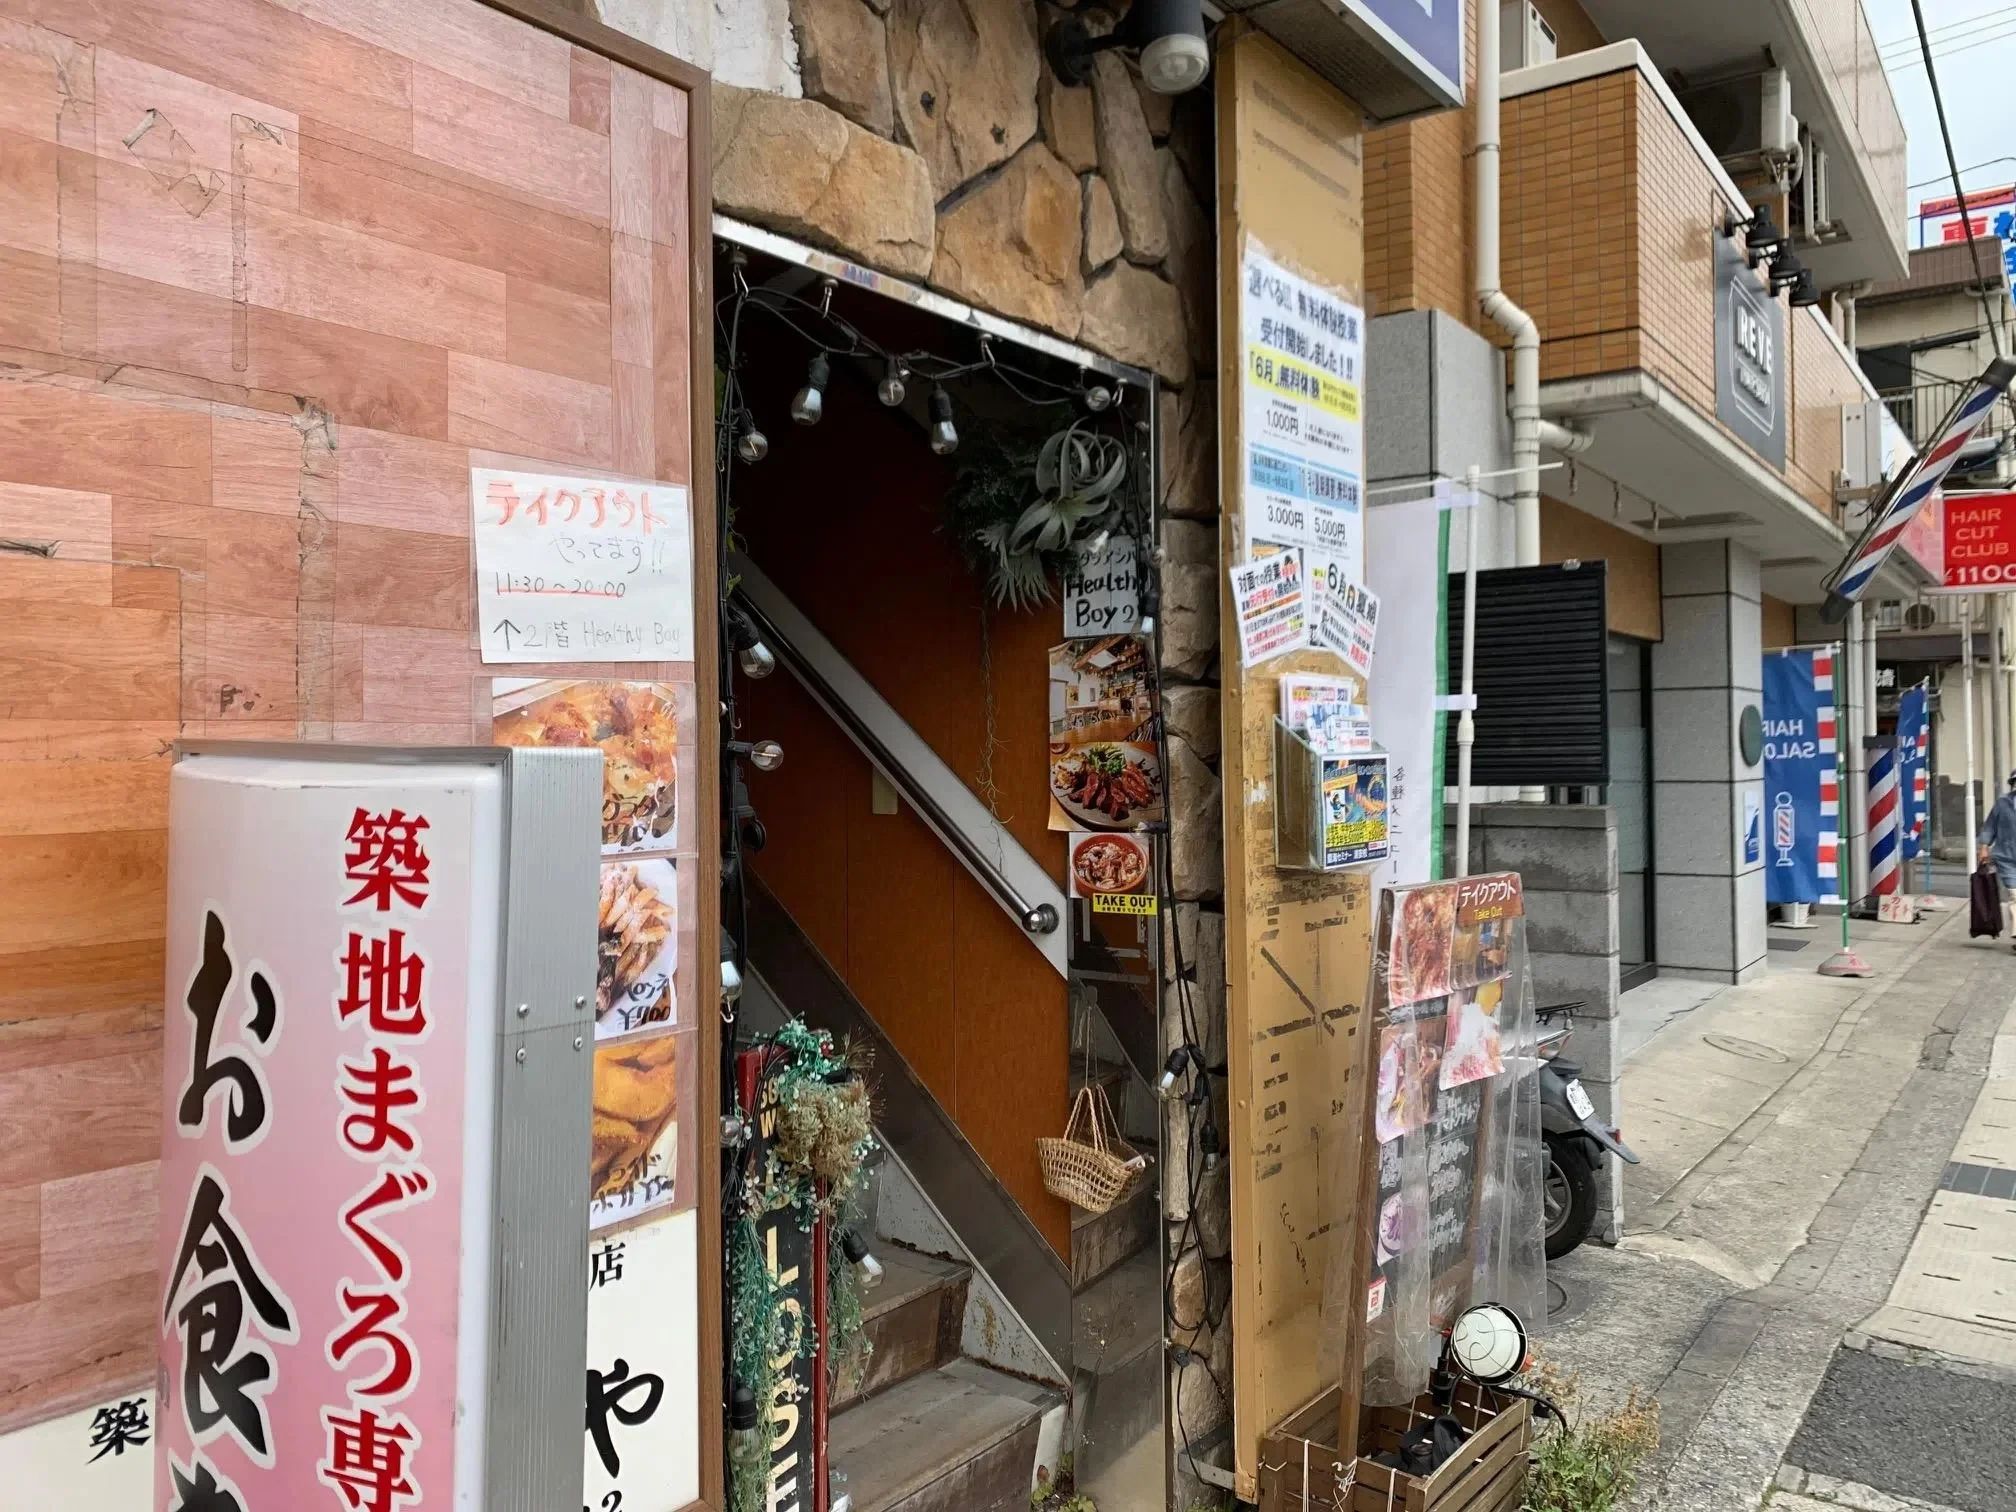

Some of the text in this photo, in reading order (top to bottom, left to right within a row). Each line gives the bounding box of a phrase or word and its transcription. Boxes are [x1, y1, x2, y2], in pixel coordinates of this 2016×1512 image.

[486, 480, 668, 536] テイクアウト
[1951, 508, 2002, 524] HAIR
[1955, 525, 1999, 541] CUT
[1951, 542, 2009, 558] CLUB
[1066, 570, 1143, 600] Health
[1076, 599, 1118, 629] Boy
[1095, 895, 1154, 908] TAKE OUT
[1461, 880, 1516, 907] テイクアウト
[589, 1242, 626, 1292] 店
[86, 1398, 152, 1465] 築
